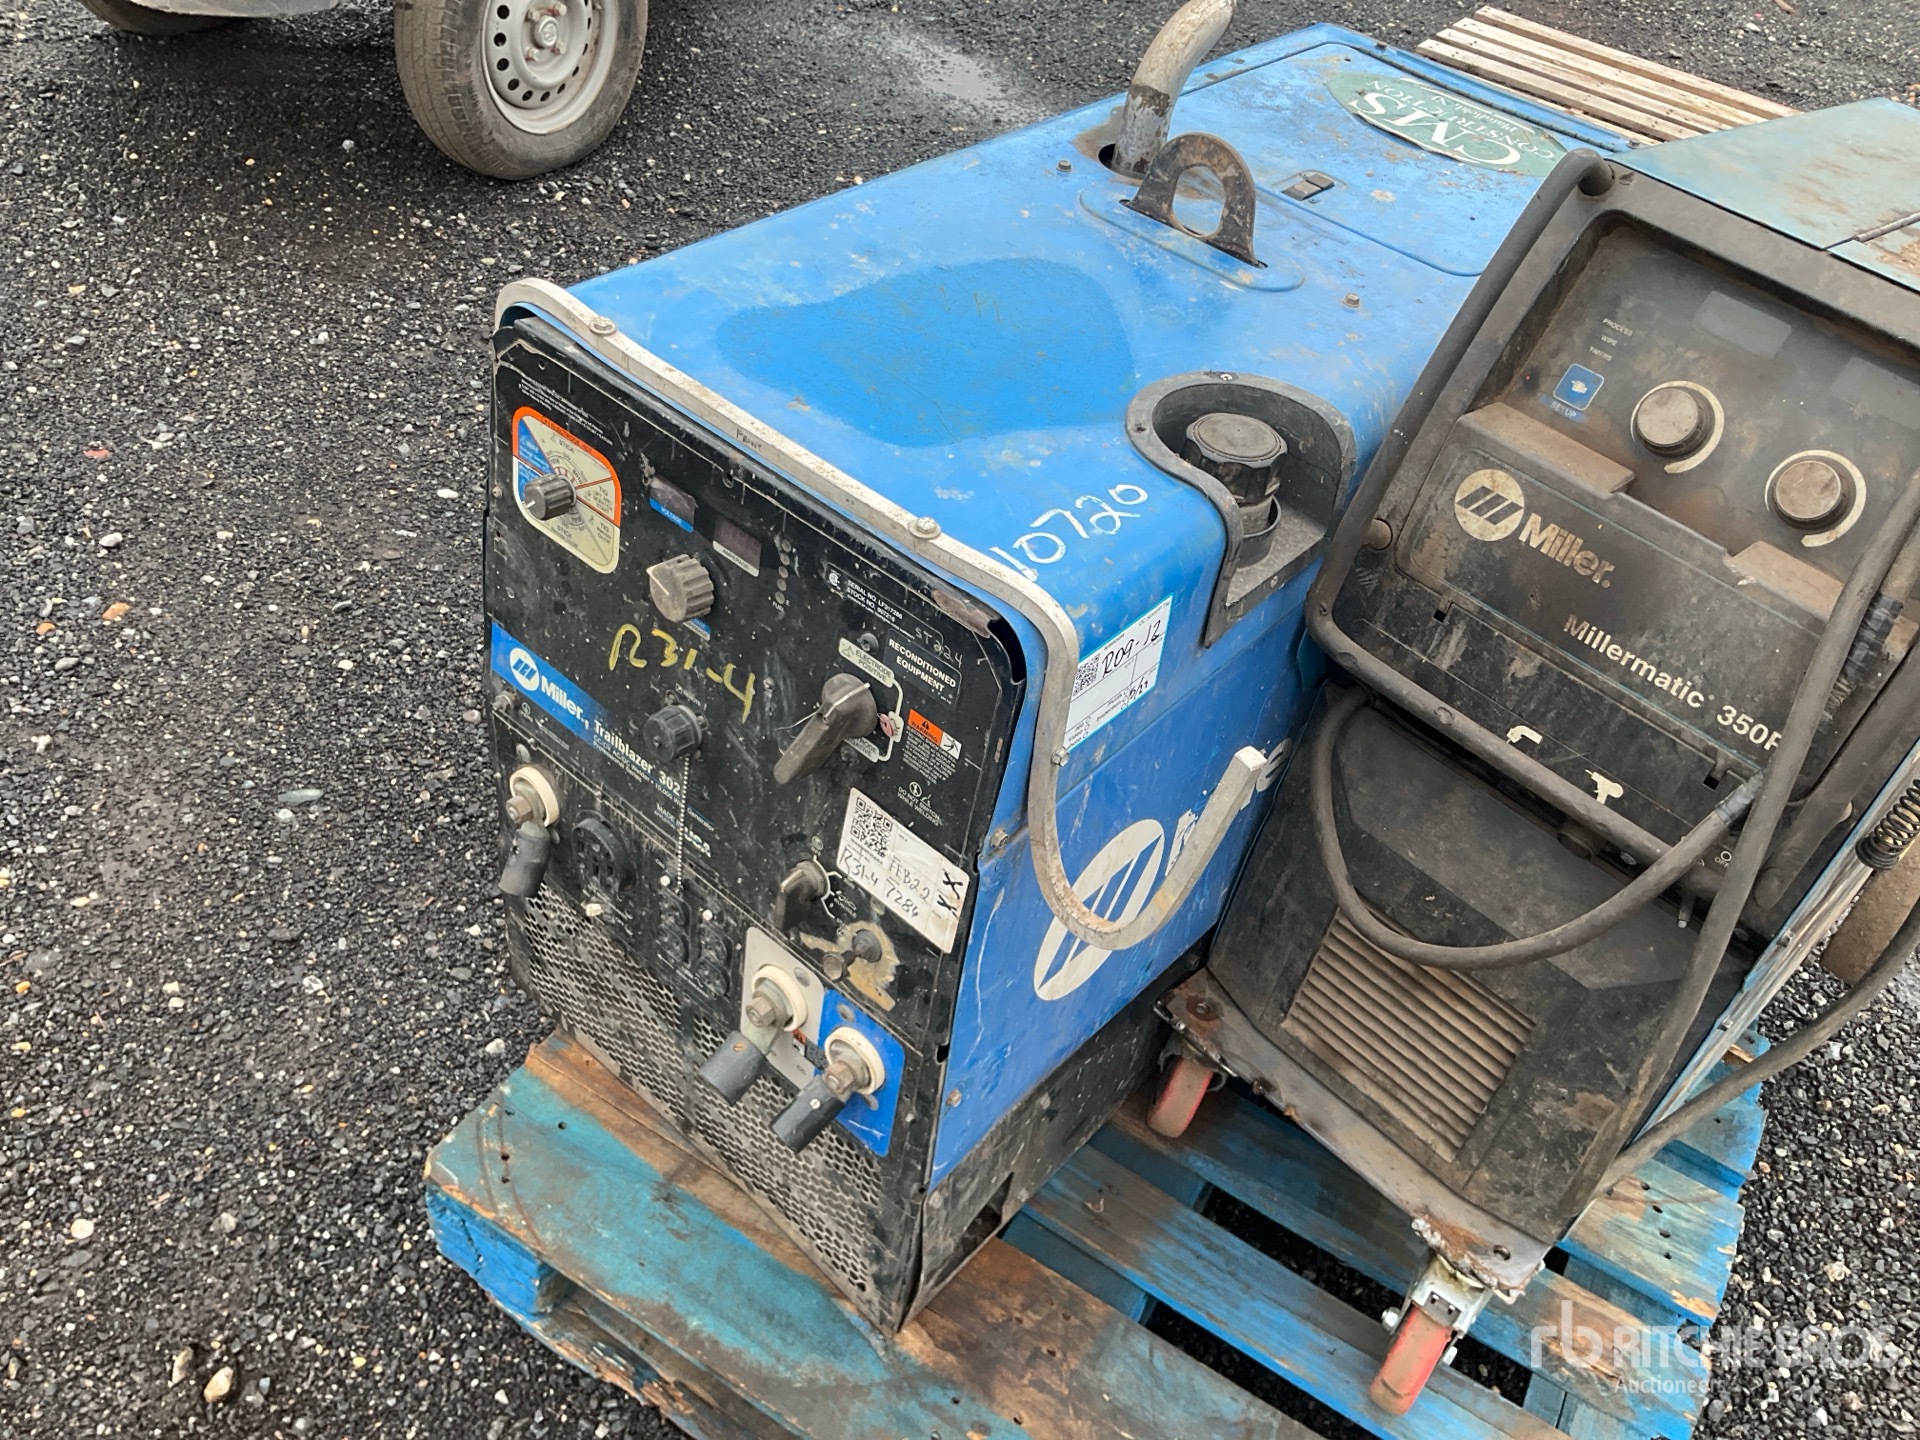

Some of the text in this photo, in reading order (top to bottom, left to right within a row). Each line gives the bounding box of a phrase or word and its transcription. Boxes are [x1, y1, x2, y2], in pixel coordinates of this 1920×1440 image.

[1348, 92, 1520, 165] CMS
[1367, 80, 1554, 160] CONSTRUCTION
[1600, 335, 1618, 347] WIPE
[1602, 318, 1633, 337] PROCESS
[1589, 346, 1613, 362] TIMERS
[1550, 401, 1577, 418] SETUP
[989, 484, 1148, 581] 10720
[1518, 512, 1616, 584] Miller
[845, 584, 865, 603] STOCK
[847, 578, 866, 597] SERIAL
[855, 649, 892, 678] ELECTRODE
[858, 659, 887, 683] POSITIVE
[888, 638, 956, 688] RECONDITIONED
[896, 655, 945, 692] EQUIPMENT
[1563, 614, 1705, 708] Millermatic
[541, 677, 585, 721] Miller
[911, 721, 938, 743] WARNING
[593, 718, 654, 774] Trailblazer
[658, 769, 681, 797] 302
[897, 790, 912, 807] WHILE
[898, 785, 940, 821] DO NOT SWITCH
